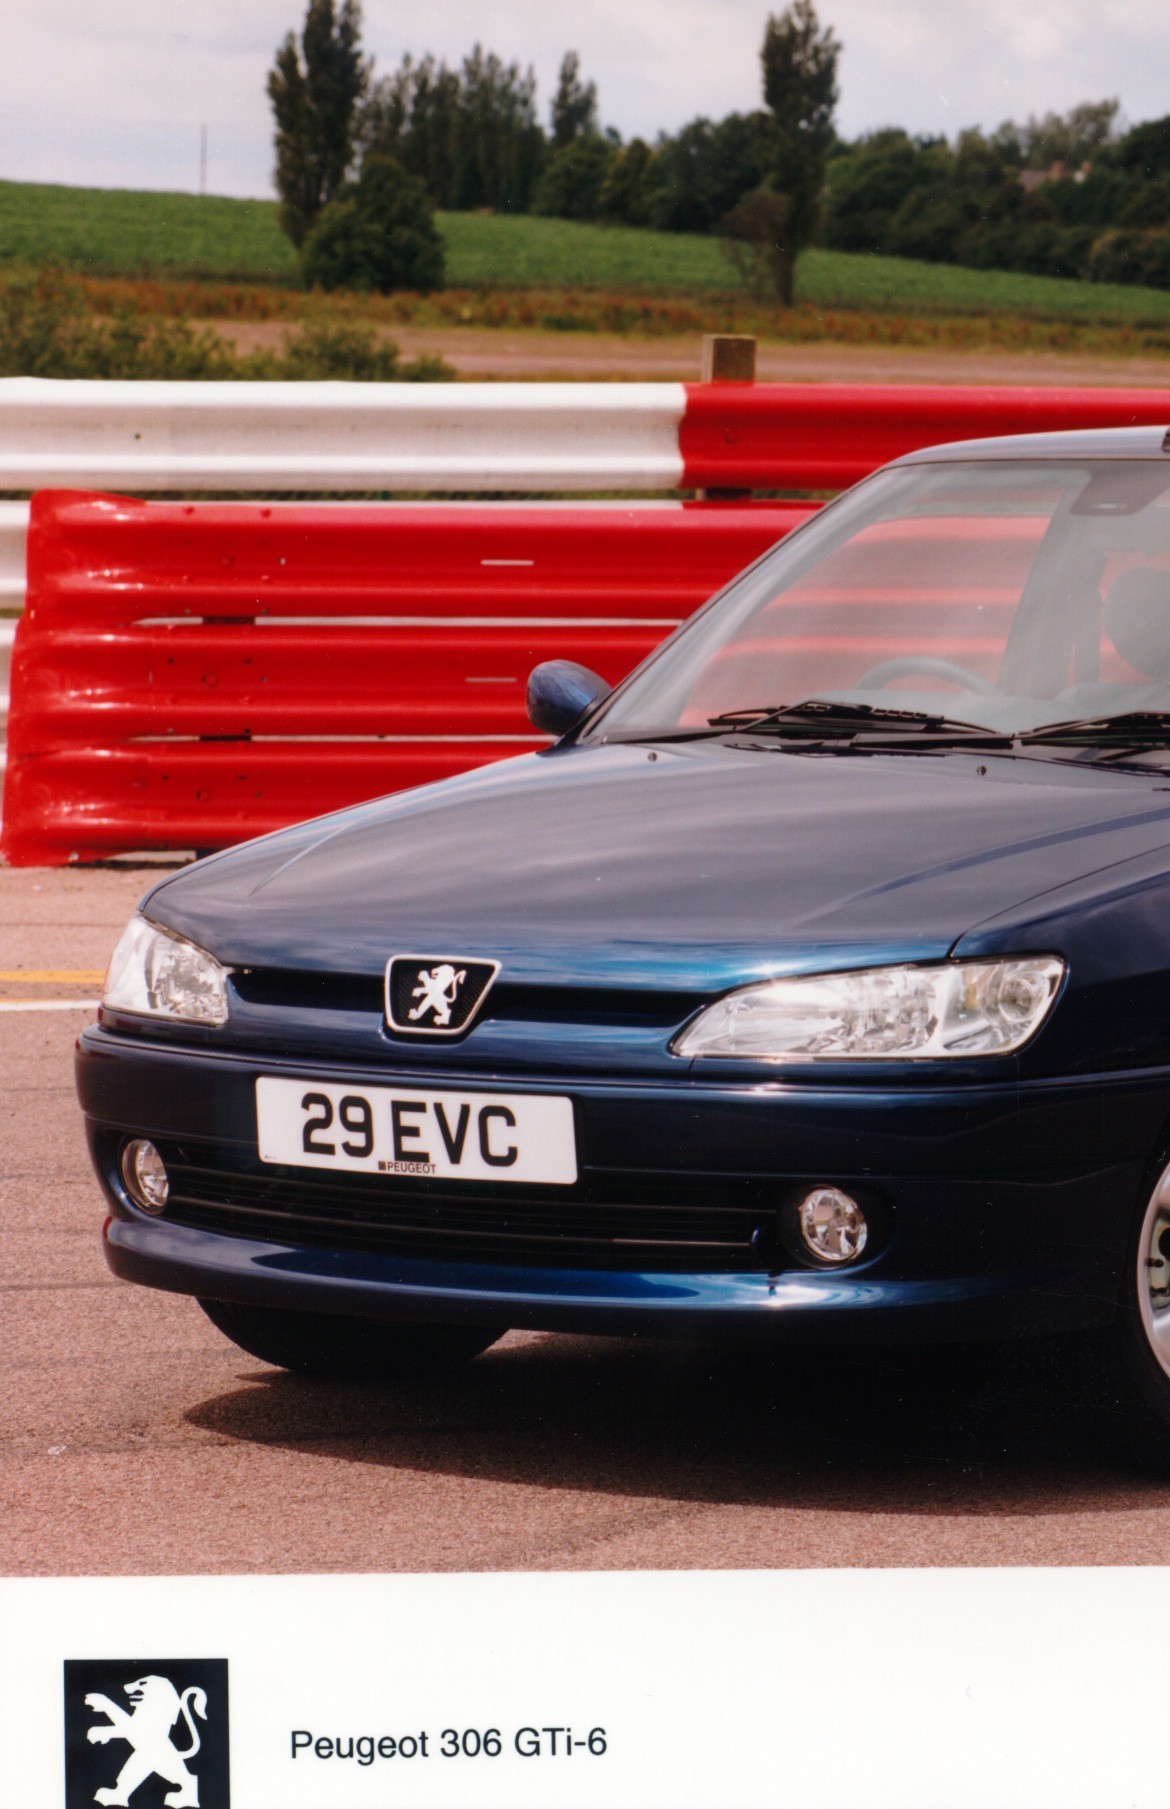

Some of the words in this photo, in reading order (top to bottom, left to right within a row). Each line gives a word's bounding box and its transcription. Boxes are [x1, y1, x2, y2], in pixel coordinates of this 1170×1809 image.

[301, 1092, 374, 1158] 29
[391, 1100, 518, 1167] EVC
[387, 1161, 436, 1174] PEUGEOT
